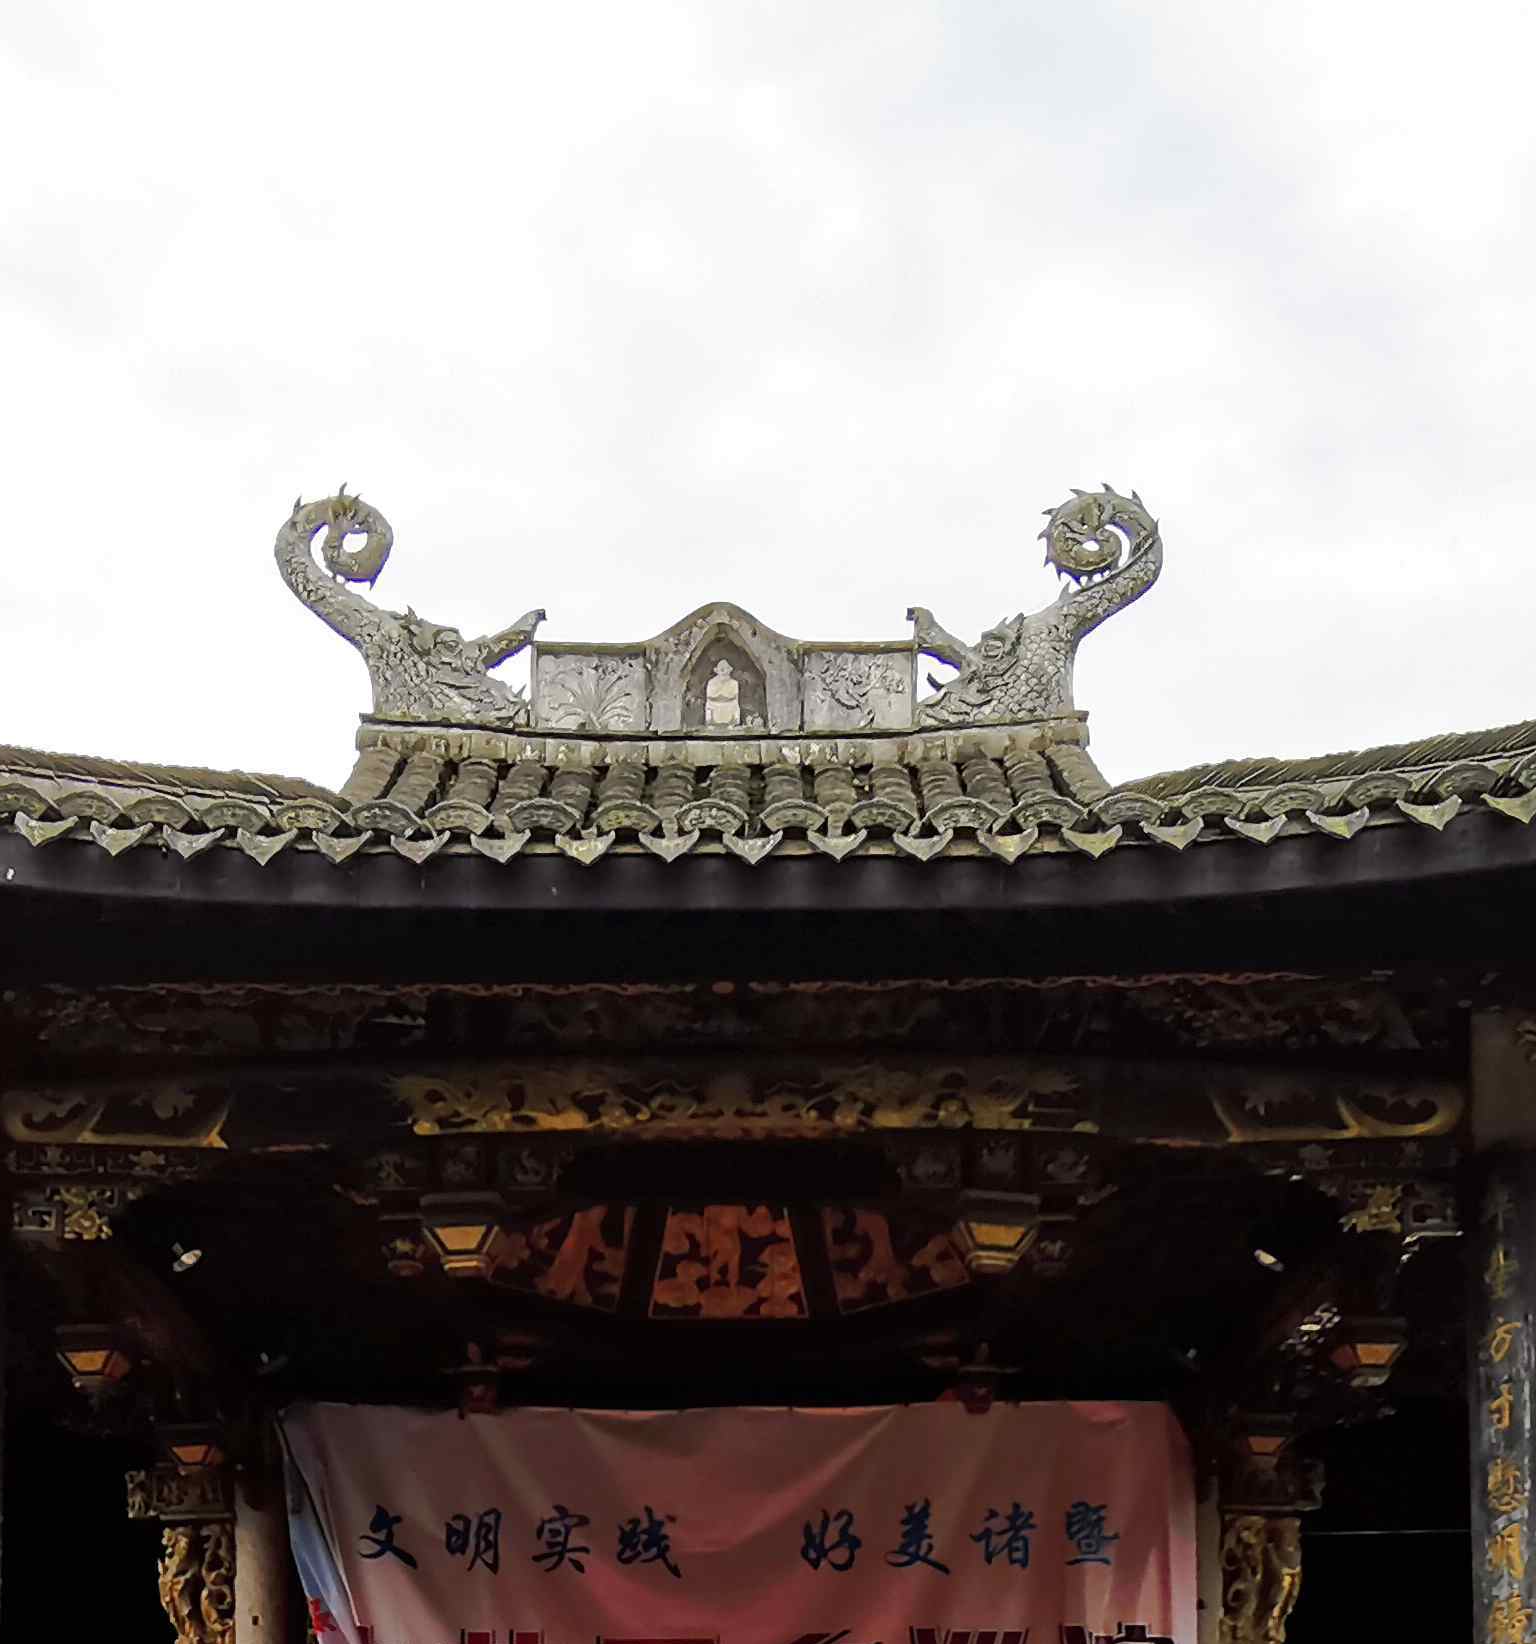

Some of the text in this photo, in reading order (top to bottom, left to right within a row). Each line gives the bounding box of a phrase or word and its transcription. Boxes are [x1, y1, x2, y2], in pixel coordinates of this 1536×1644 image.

[358, 1499, 1120, 1577] 文明实践 好美诸暨
